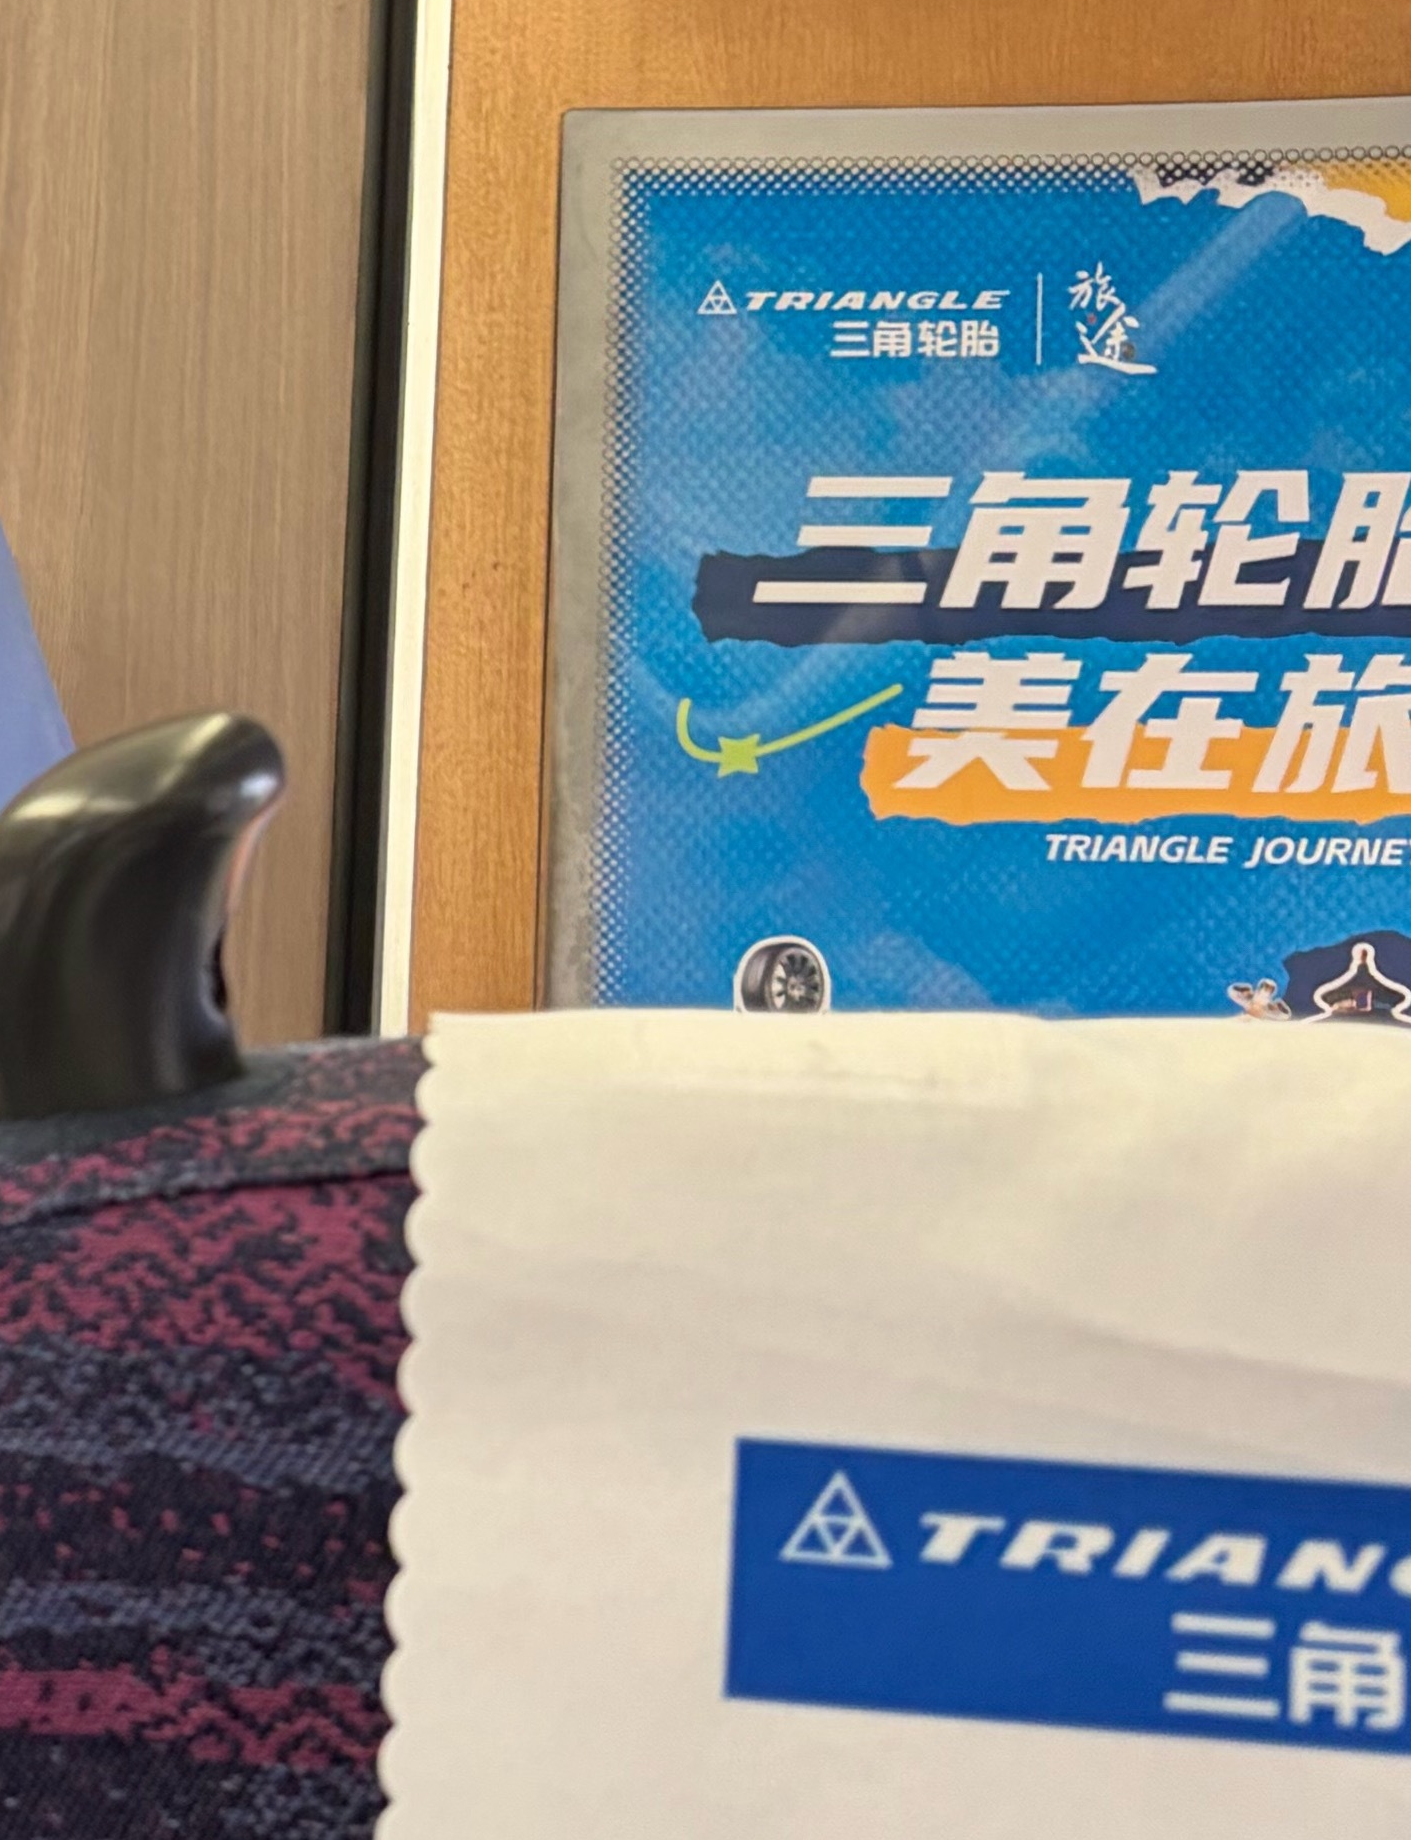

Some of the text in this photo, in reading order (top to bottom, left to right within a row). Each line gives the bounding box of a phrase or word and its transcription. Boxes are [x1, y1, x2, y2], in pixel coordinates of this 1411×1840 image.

[745, 289, 1011, 311] TRIANGLE
[830, 320, 1000, 358] 三角轮胎
[1045, 833, 1411, 869] TRIANGLE JOURNE
[1163, 1612, 1408, 1730] 三角
